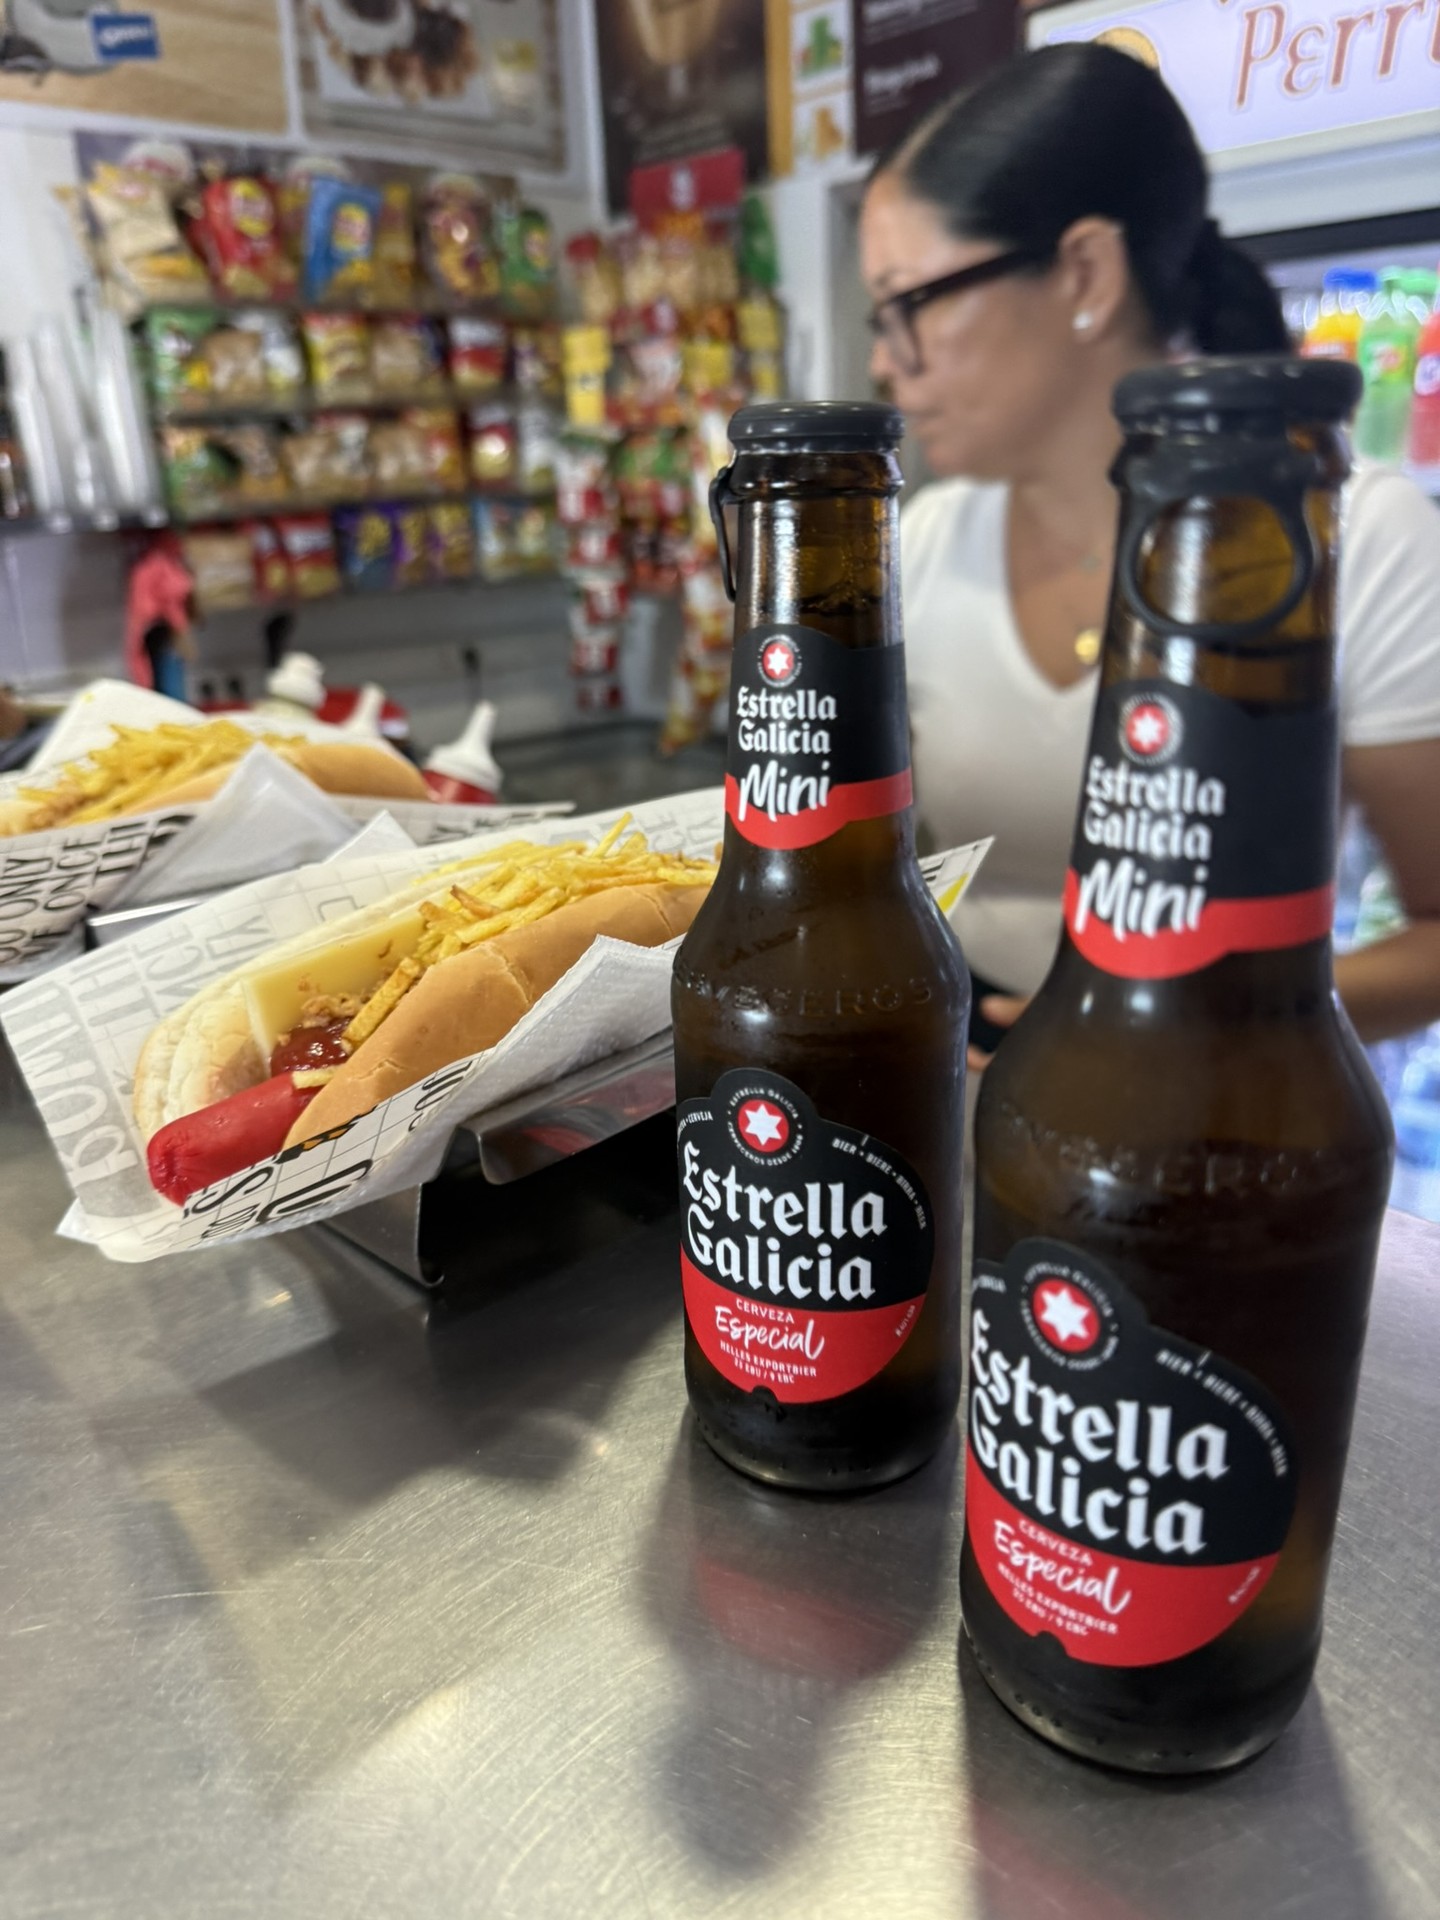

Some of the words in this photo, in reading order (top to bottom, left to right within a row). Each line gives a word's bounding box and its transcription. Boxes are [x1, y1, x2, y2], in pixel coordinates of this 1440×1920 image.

[1236, 0, 1440, 107] Perr
[737, 685, 837, 720] Estrella
[738, 720, 831, 754] Galicia
[738, 760, 830, 822] Mini
[1086, 755, 1226, 816] Estrella
[1085, 800, 1212, 860] Galicia
[1074, 856, 1208, 942] Mini
[767, 1089, 799, 1119] GALICIA
[832, 1137, 857, 1155] BIER
[683, 1140, 888, 1239] Estrella
[688, 1203, 876, 1301] Galicia
[715, 1306, 825, 1360] Especial
[736, 1298, 795, 1324] CERVEZA
[753, 1354, 817, 1377] EXPORTBIER
[971, 1308, 1231, 1481] Estrella
[971, 1386, 1208, 1555] Galicia
[994, 1519, 1132, 1615] Especial
[1018, 1520, 1093, 1566] CERVEZA
